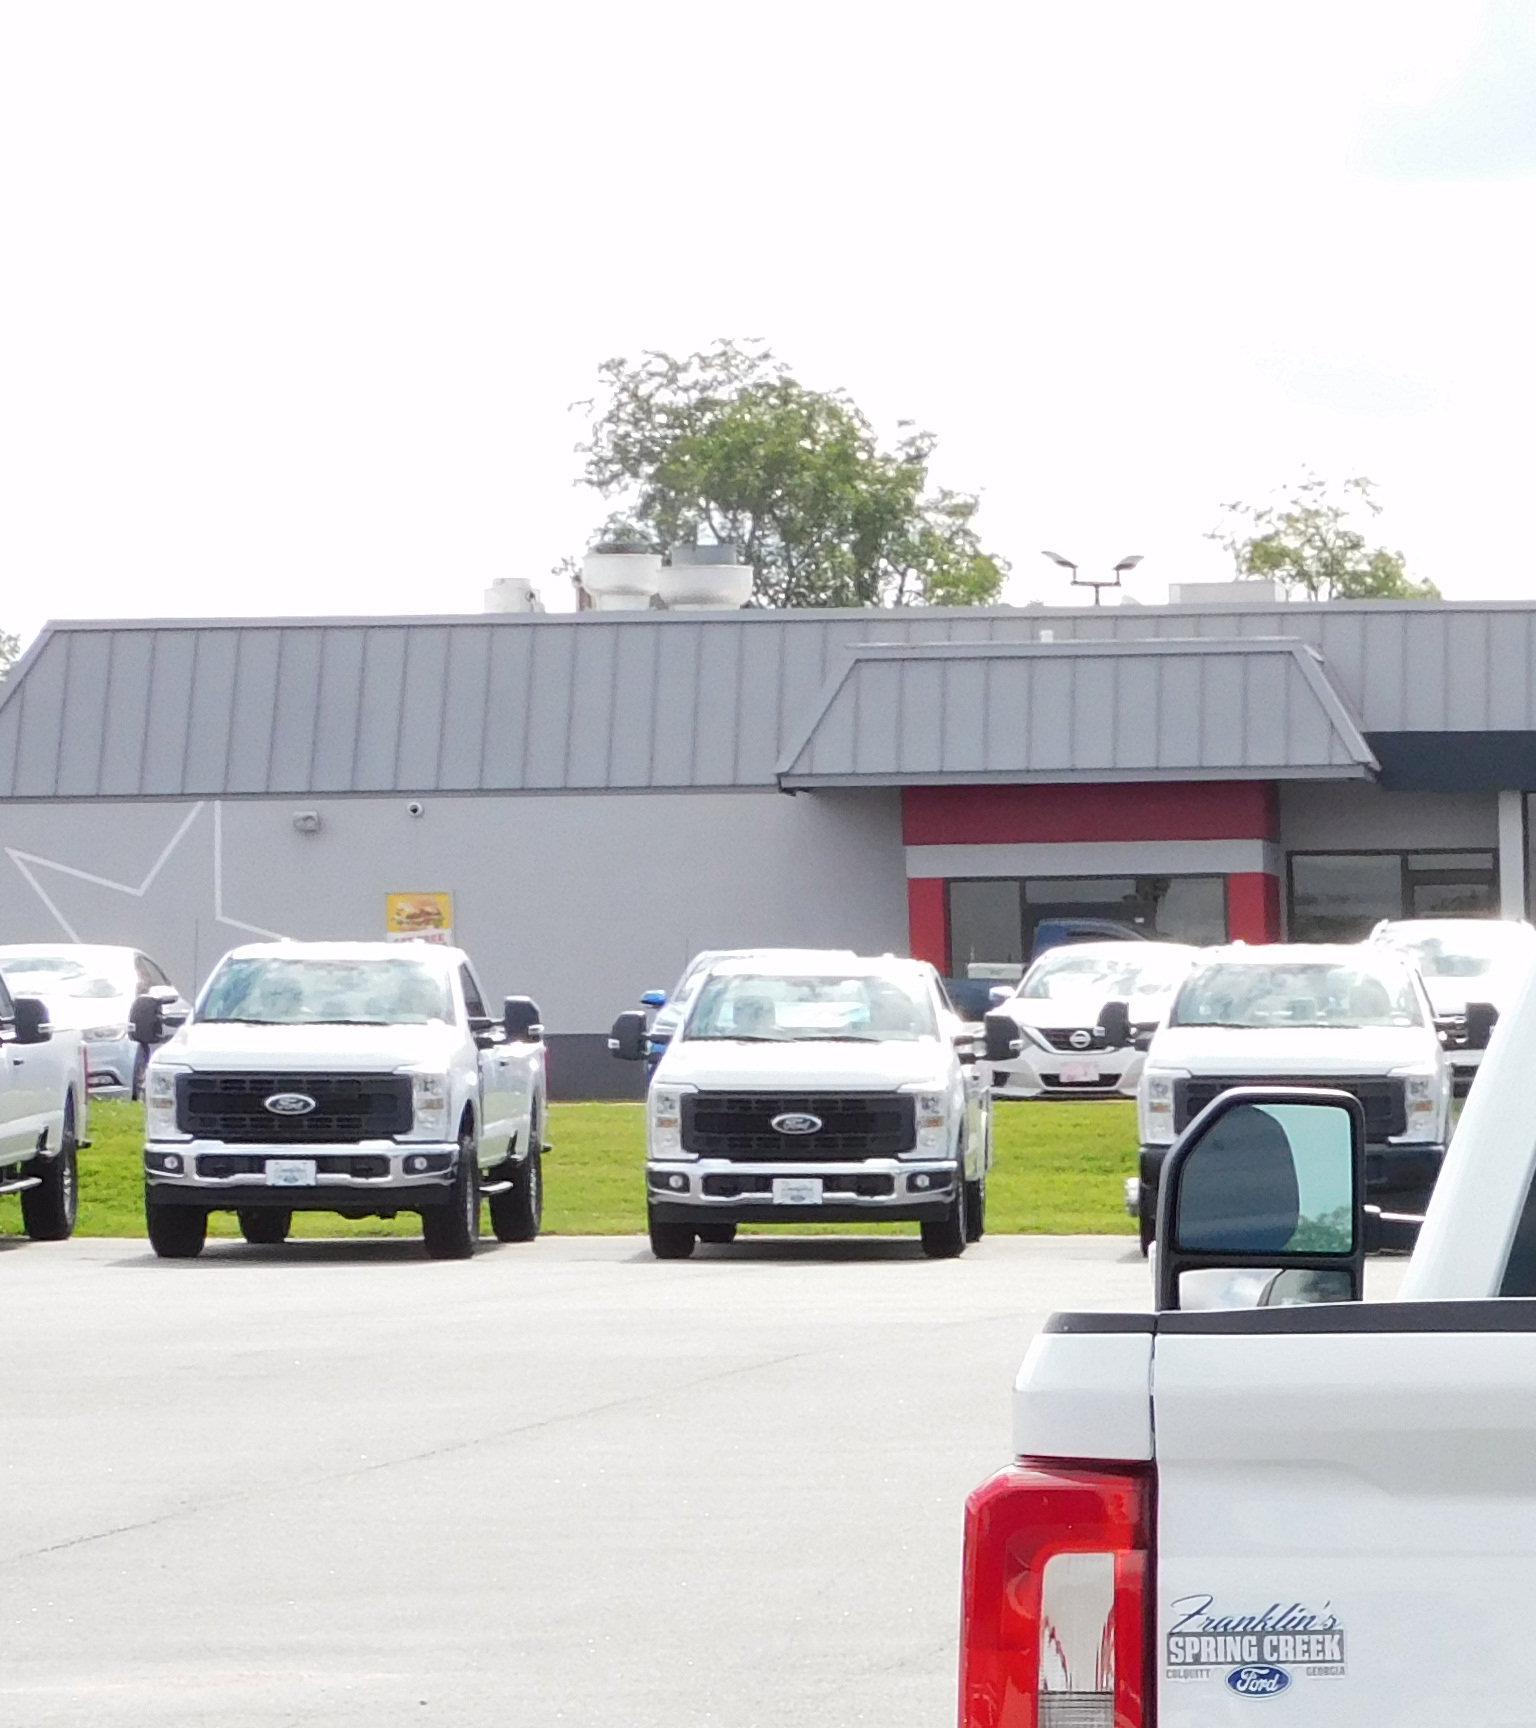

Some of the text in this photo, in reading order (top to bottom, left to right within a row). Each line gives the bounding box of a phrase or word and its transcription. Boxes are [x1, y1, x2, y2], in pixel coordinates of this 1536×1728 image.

[1169, 1594, 1340, 1635] Franklin's
[1169, 1634, 1342, 1664] SPRING CREEK
[1236, 1668, 1279, 1692] Ford
